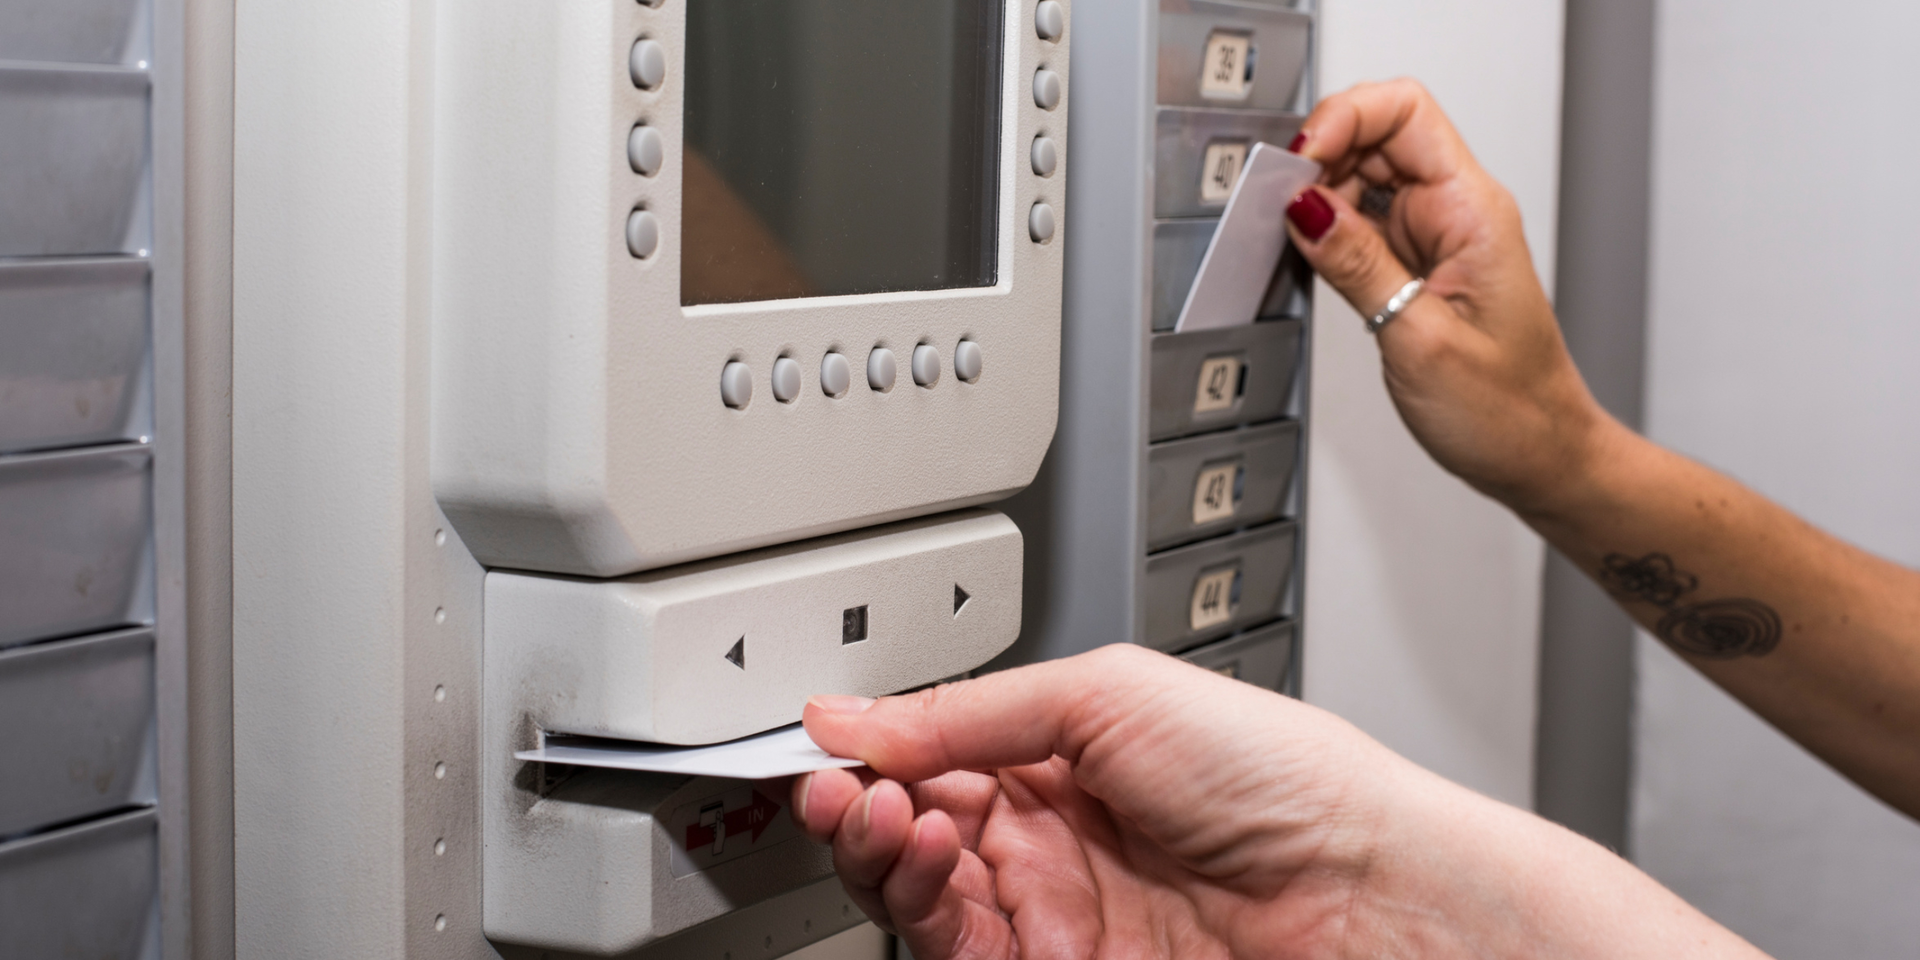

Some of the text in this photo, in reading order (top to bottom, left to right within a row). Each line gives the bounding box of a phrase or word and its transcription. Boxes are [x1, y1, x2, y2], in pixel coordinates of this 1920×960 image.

[1214, 45, 1236, 83] 39
[1213, 154, 1234, 190] 40
[1207, 364, 1228, 400] 42
[1203, 473, 1225, 510] 43
[1201, 580, 1222, 615] 44
[748, 807, 764, 824] IN
